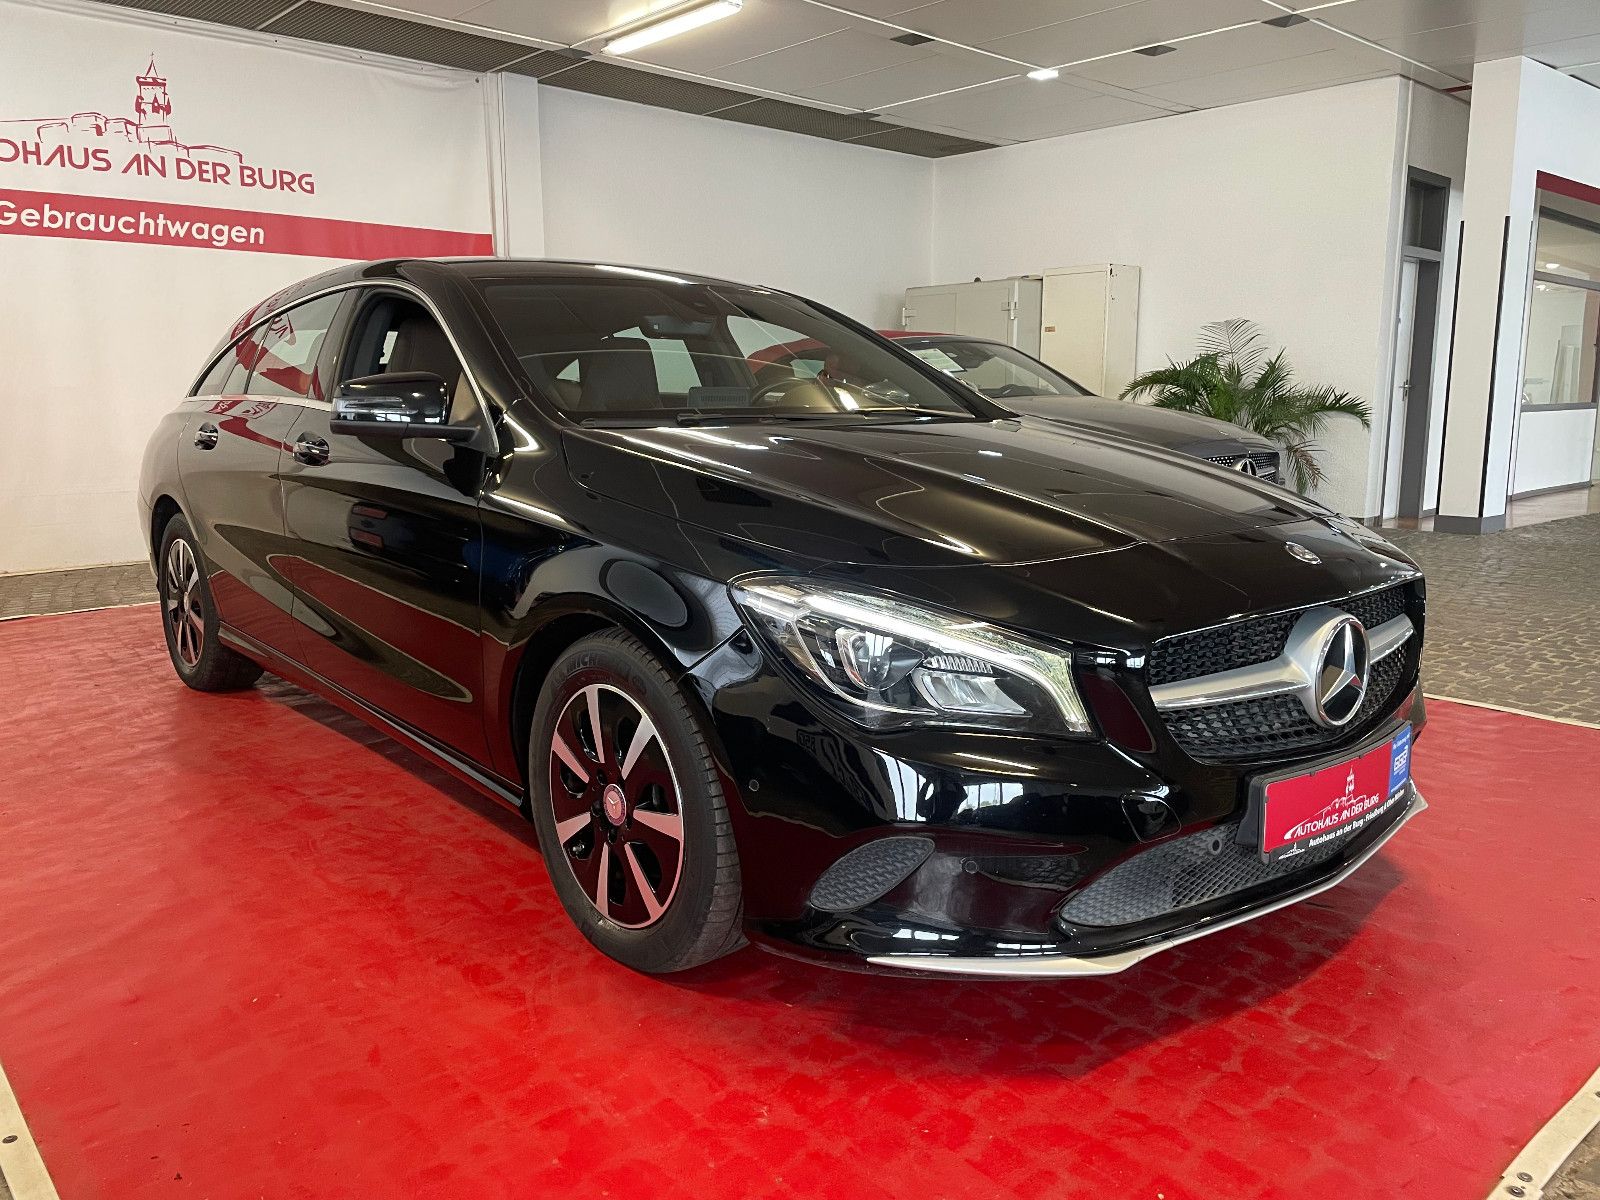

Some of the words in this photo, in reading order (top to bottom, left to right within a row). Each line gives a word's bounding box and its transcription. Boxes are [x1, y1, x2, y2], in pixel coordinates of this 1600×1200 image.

[122, 153, 167, 178] AN
[176, 157, 230, 185] DER
[240, 166, 315, 195] BURG
[0, 200, 265, 247] Gebrauchtwagen
[1294, 812, 1339, 838] AUTOHAUS
[1339, 808, 1351, 821] AN
[1351, 802, 1363, 815] DER
[1363, 793, 1379, 811] BURG
[1308, 831, 1336, 848] Autohaus
[1336, 828, 1343, 837] an
[1344, 823, 1353, 834] der
[1352, 818, 1364, 830] Burg
